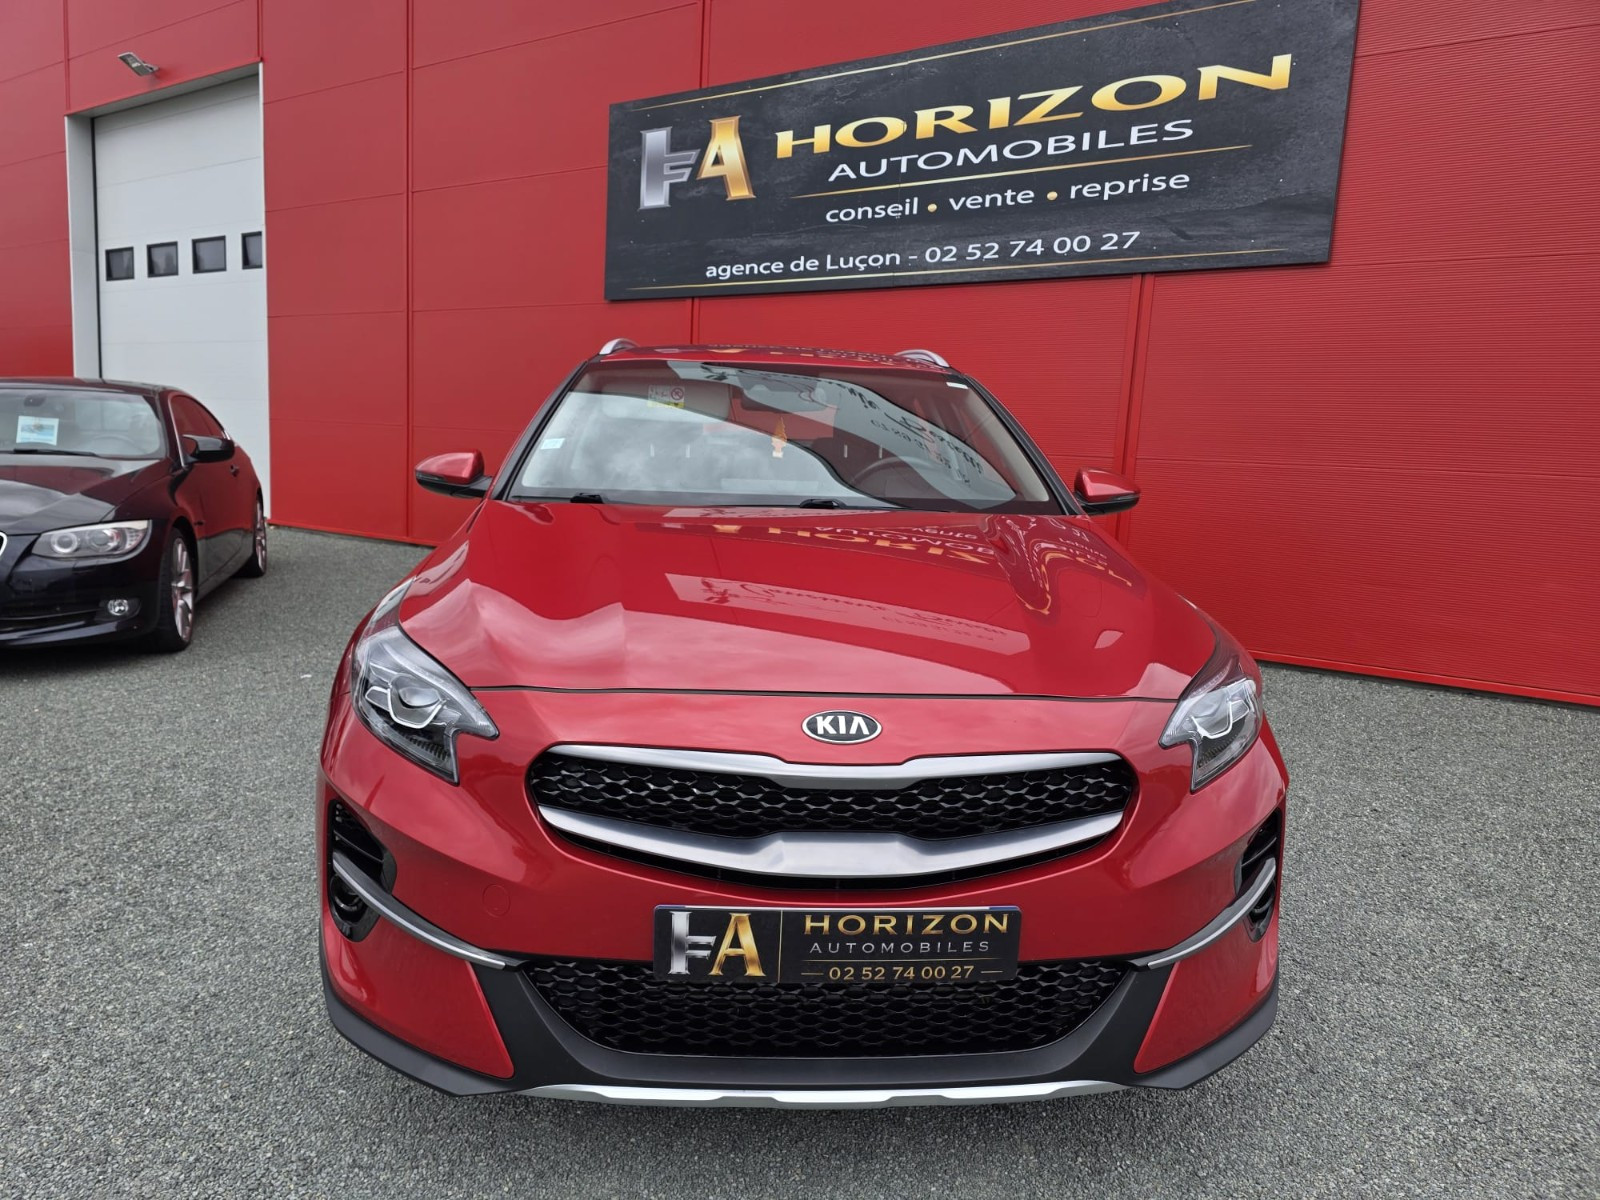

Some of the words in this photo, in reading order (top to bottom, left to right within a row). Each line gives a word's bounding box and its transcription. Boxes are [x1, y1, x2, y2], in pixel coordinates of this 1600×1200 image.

[775, 54, 1292, 159] HORIZON
[828, 119, 1194, 182] AUTOMOBILES
[825, 197, 918, 222] conseil
[949, 189, 1035, 211] vente
[1070, 173, 1190, 201] reprise
[705, 261, 784, 280] agence
[790, 256, 819, 272] de
[826, 252, 900, 274] Luçon
[925, 246, 957, 263] 02
[966, 243, 999, 260] 52
[1009, 239, 1045, 257] 74
[1053, 234, 1091, 254] 00
[1100, 231, 1141, 251] 27
[815, 715, 870, 735] KIA
[804, 913, 1009, 936] HORIZON
[810, 941, 990, 954] AUTOMOBILES
[828, 966, 855, 980] 02
[861, 966, 887, 981] 52
[892, 966, 918, 979] 74
[921, 966, 947, 979] 00
[951, 965, 975, 979] 27
